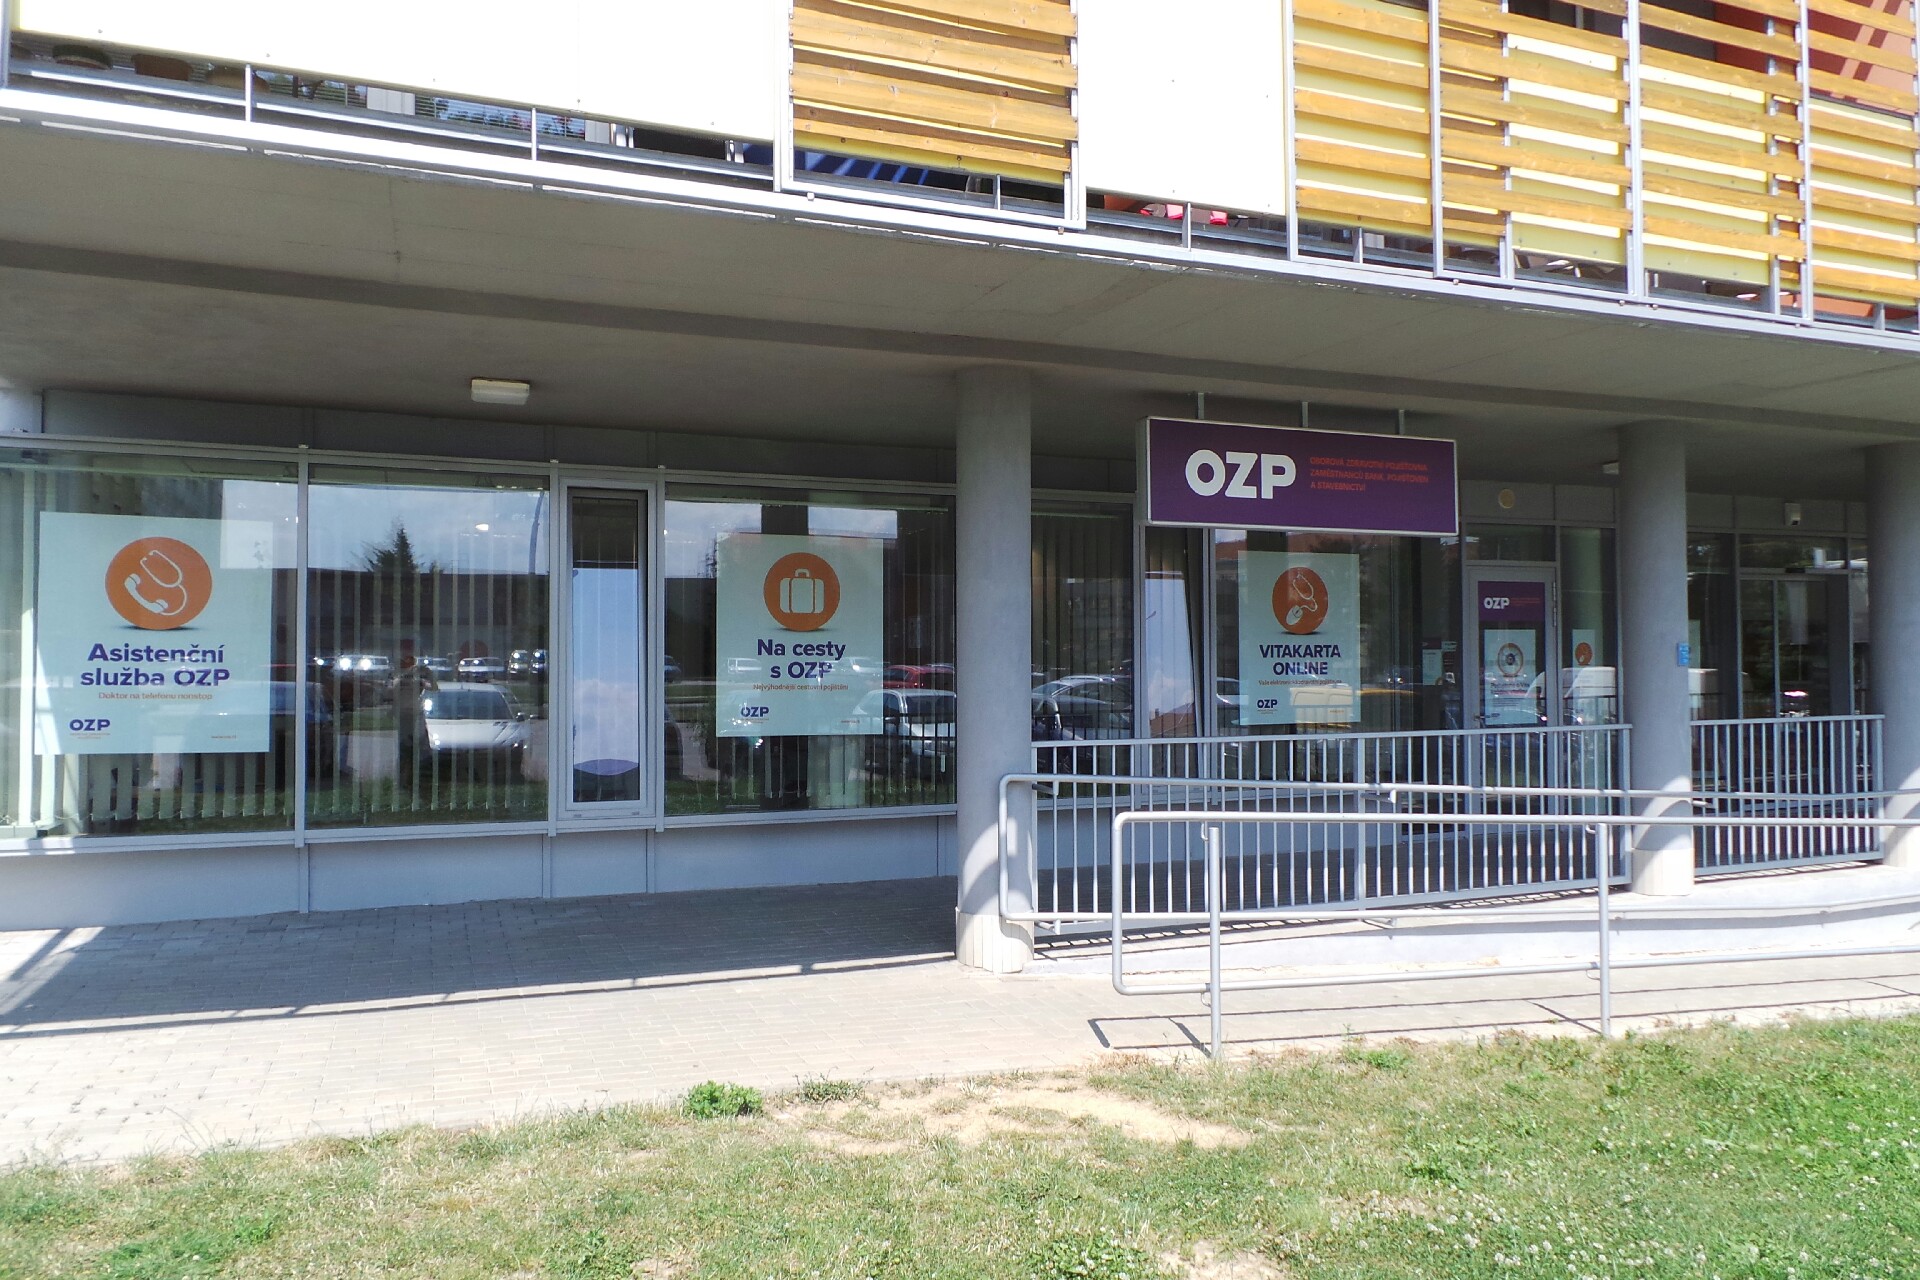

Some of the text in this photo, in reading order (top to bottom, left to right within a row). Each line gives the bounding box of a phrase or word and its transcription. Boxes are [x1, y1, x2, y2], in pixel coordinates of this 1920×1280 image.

[1185, 449, 1297, 500] OZP
[1484, 597, 1510, 609] OZP
[88, 643, 225, 663] Asistenční
[757, 639, 846, 660] Na cesty
[1259, 644, 1341, 658] VITAKARTA
[770, 661, 833, 679] s OZP
[1273, 662, 1328, 675] ONLINE
[80, 667, 230, 686] služba OZP
[1257, 699, 1278, 709] OZP
[741, 706, 769, 717] OZP
[69, 719, 111, 731] OZP
